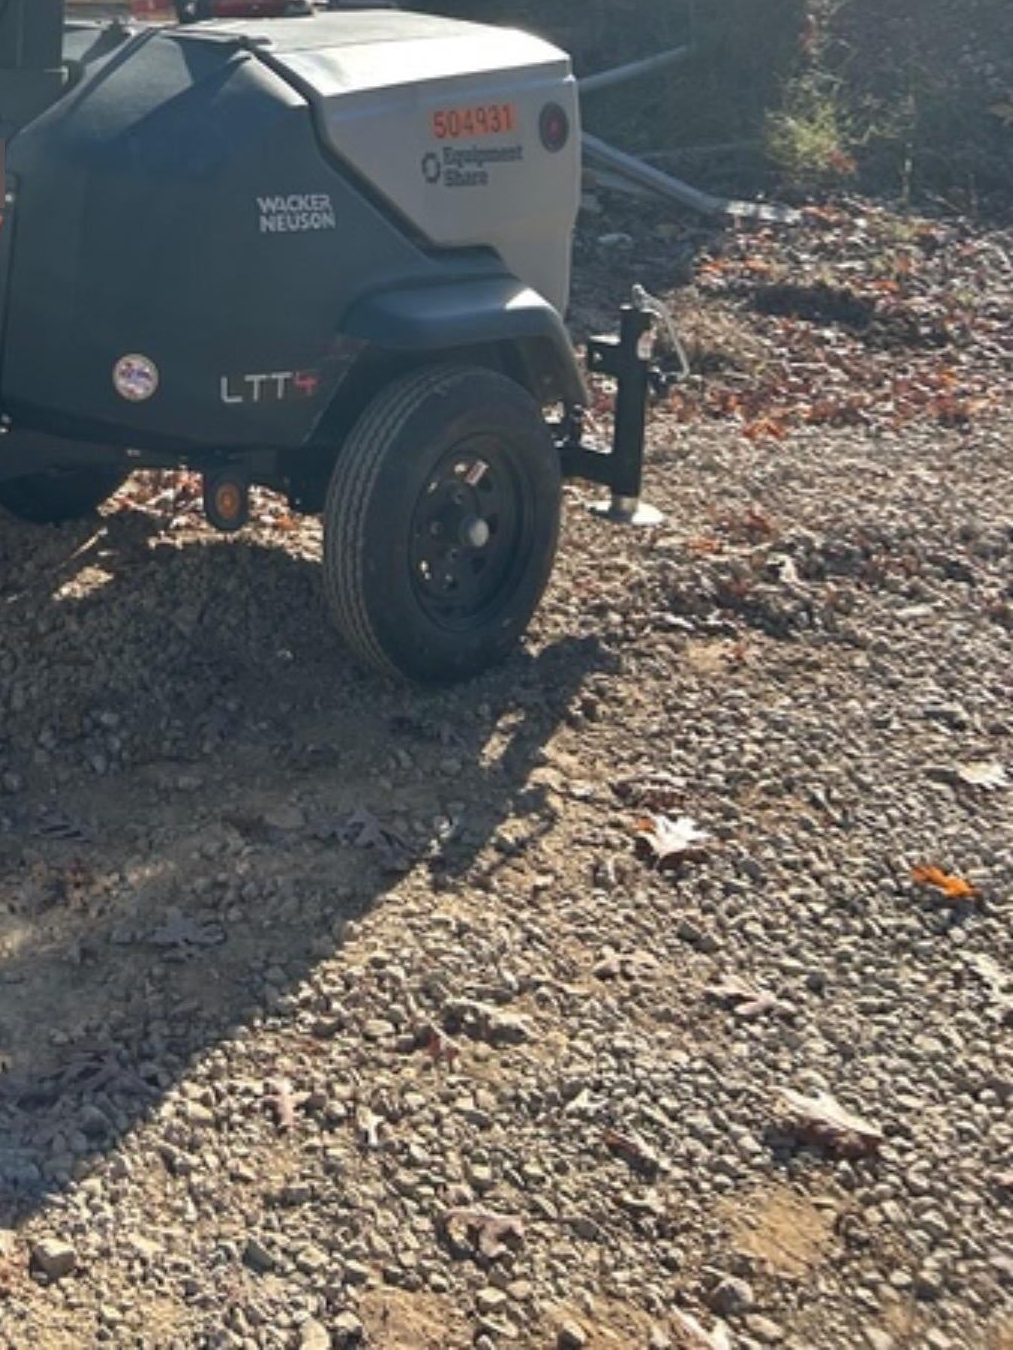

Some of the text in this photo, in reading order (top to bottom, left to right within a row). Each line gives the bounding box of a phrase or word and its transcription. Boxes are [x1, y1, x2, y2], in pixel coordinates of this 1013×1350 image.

[433, 104, 510, 139] 504931
[443, 144, 524, 168] Equipment
[256, 193, 333, 213] WACKER
[259, 212, 336, 233] NEUSON
[220, 371, 317, 403] LTT4
